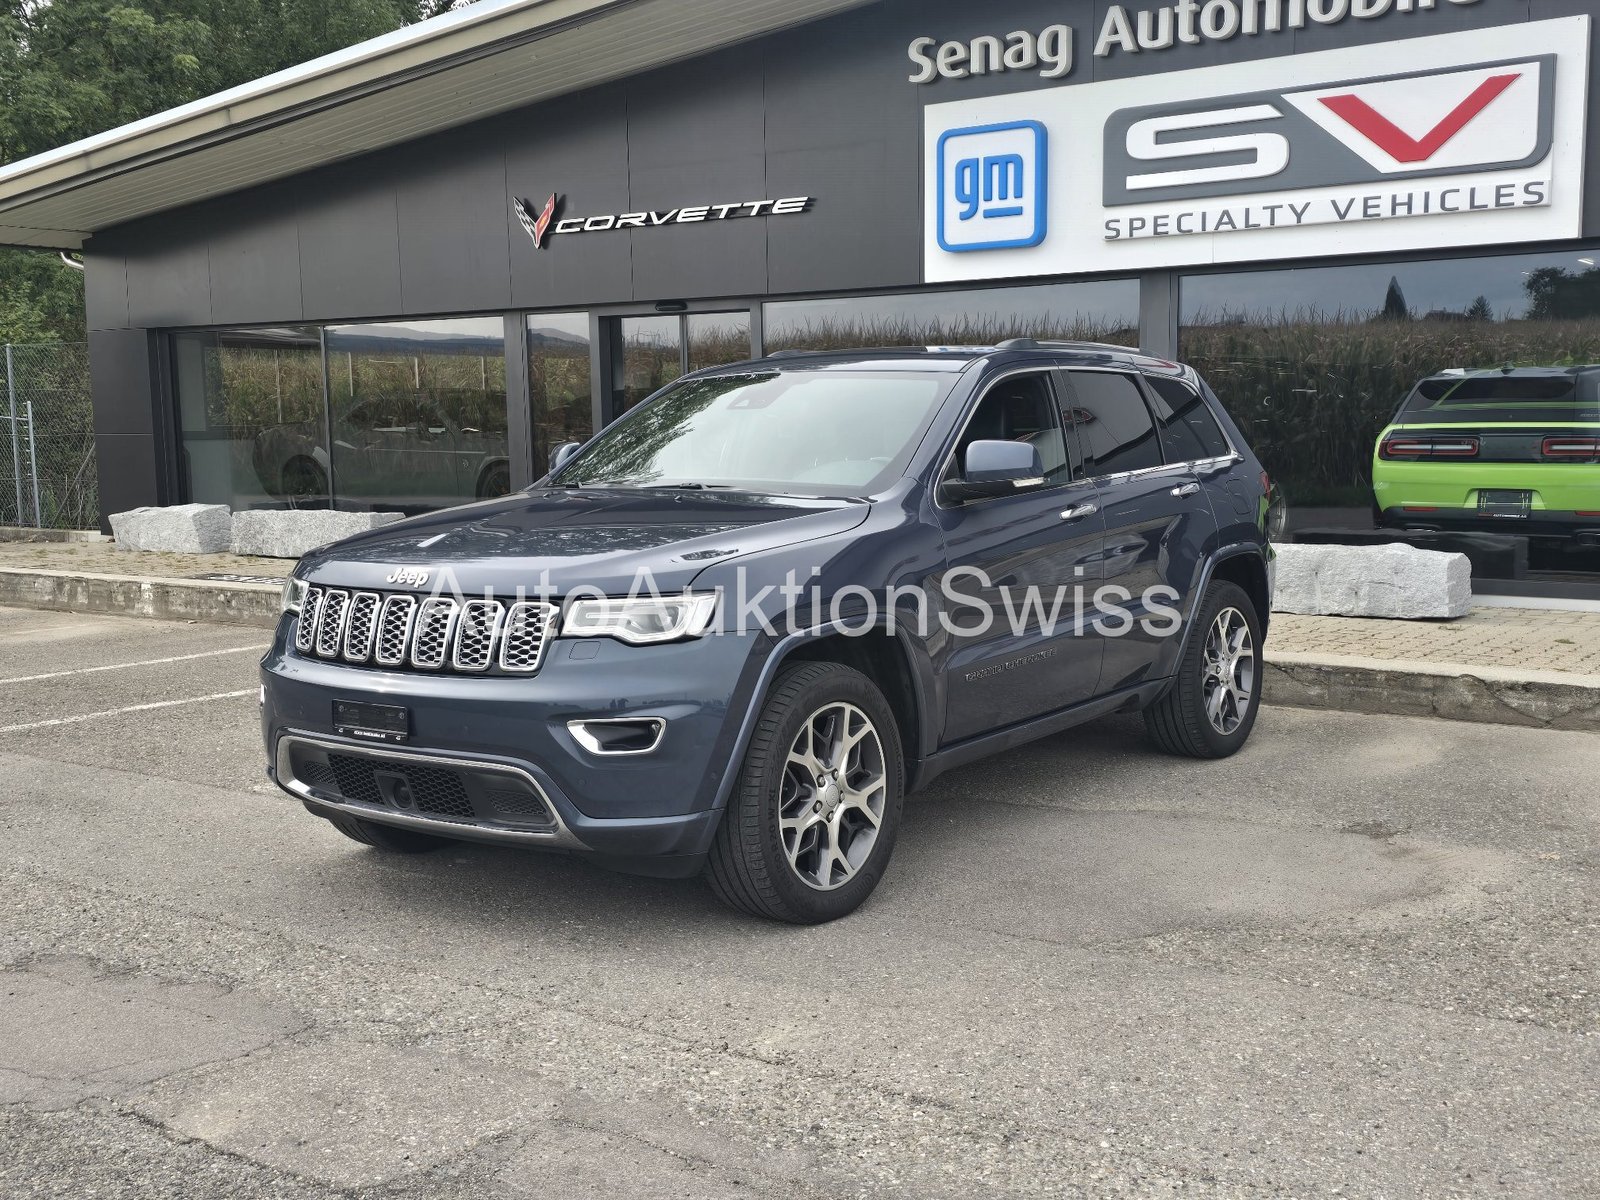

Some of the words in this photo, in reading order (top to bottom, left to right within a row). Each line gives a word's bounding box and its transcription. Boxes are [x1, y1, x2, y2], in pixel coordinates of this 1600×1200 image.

[908, 24, 1073, 83] Senag
[1093, 0, 1480, 57] Automo
[1126, 73, 1523, 190] SV
[555, 196, 809, 234] CORVETTE
[955, 153, 1023, 221] gm
[1104, 202, 1311, 240] SPECIALTY
[1330, 181, 1545, 220] VEHICLES
[386, 567, 430, 589] Jeep
